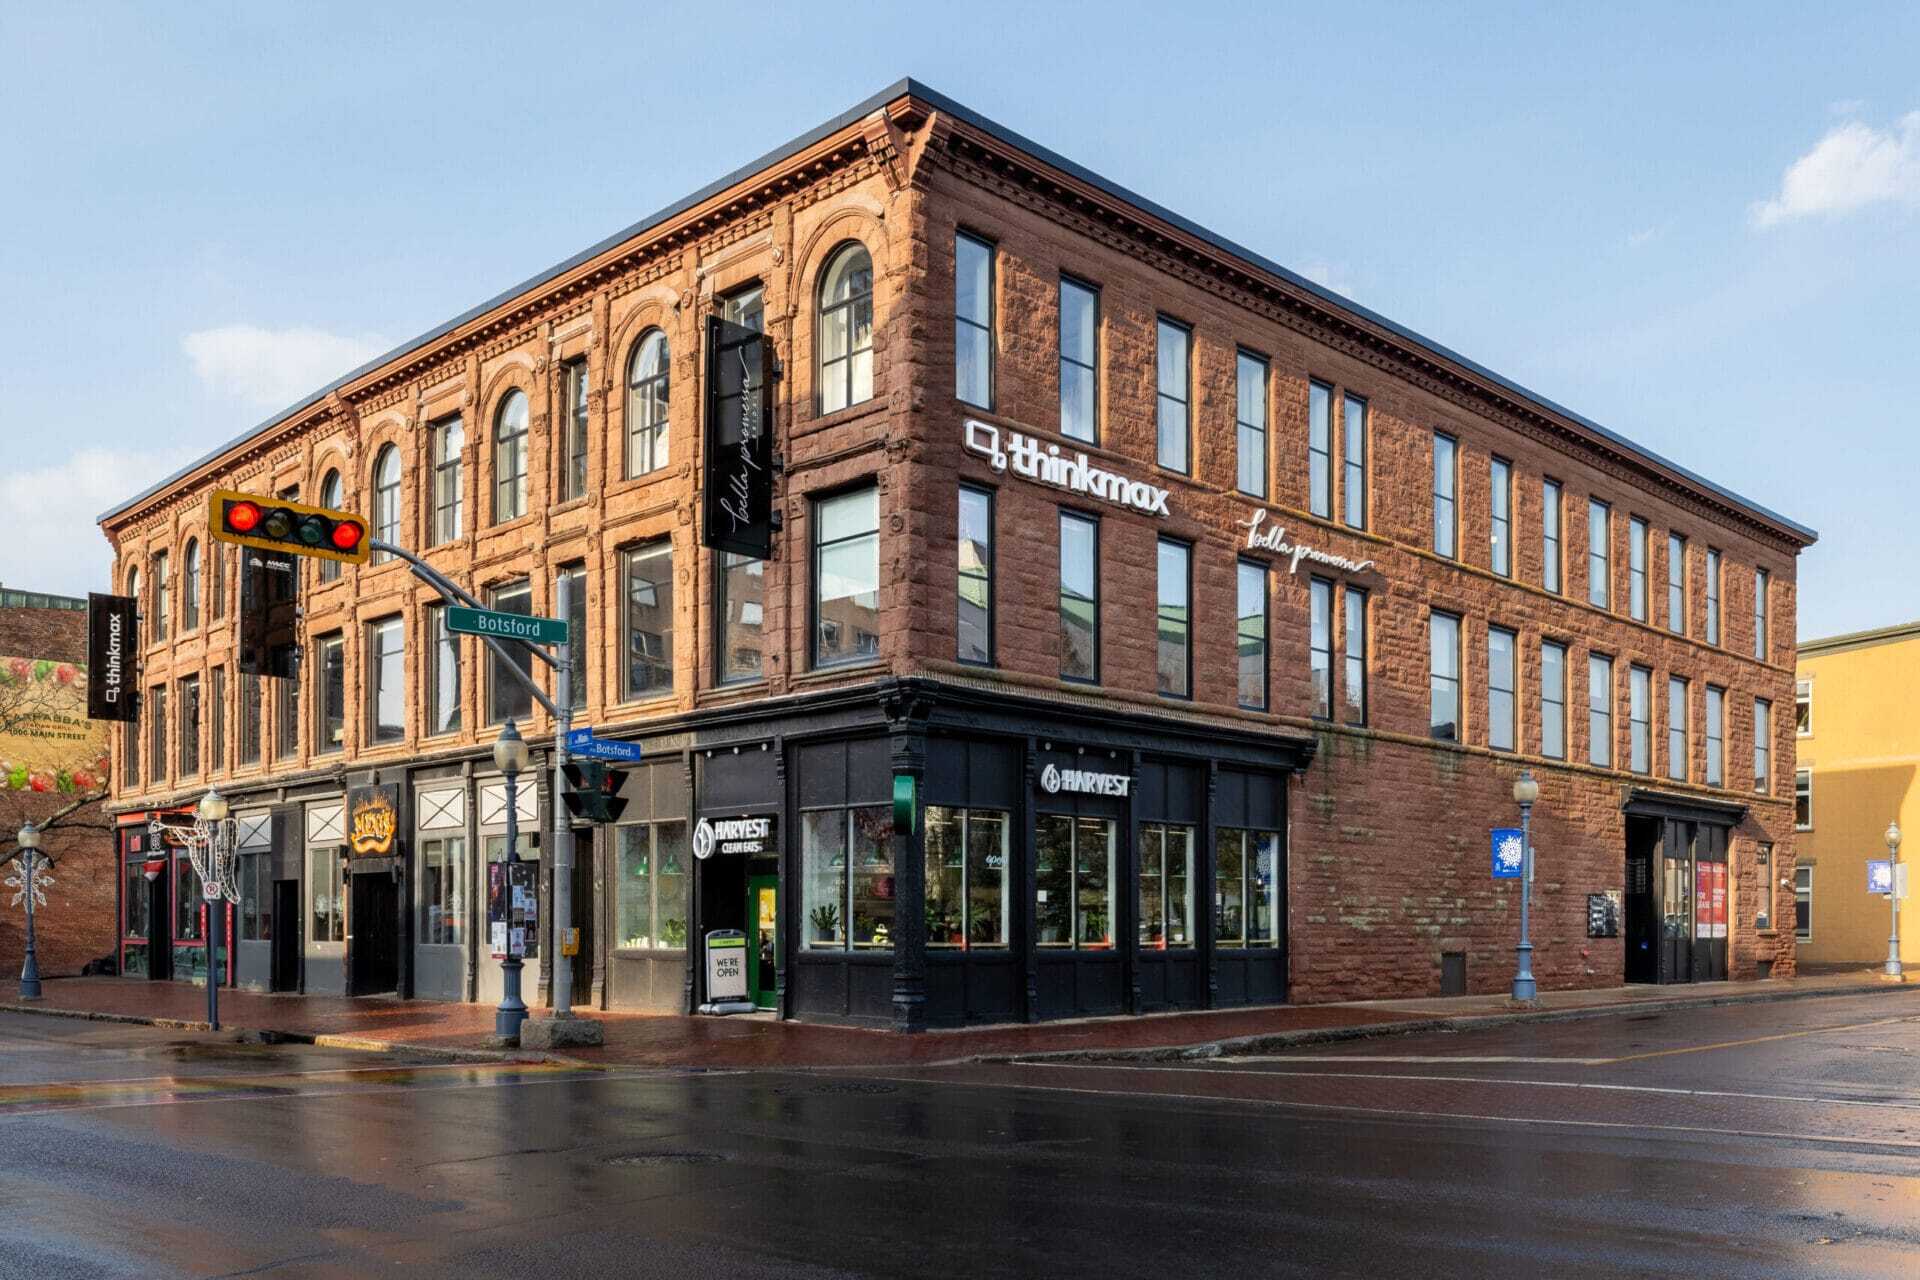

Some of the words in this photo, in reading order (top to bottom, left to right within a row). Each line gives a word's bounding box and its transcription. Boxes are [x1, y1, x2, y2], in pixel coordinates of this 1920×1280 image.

[1008, 432, 1170, 516] thinkmax
[478, 615, 540, 636] Botsford
[106, 613, 120, 685] thinkmax
[31, 729, 55, 738] MAIN
[57, 732, 86, 740] STREET
[596, 743, 631, 756] Botsford
[1061, 769, 1130, 797] HARVEST
[714, 819, 770, 840] HARVEST
[717, 968, 739, 977] OPEN
